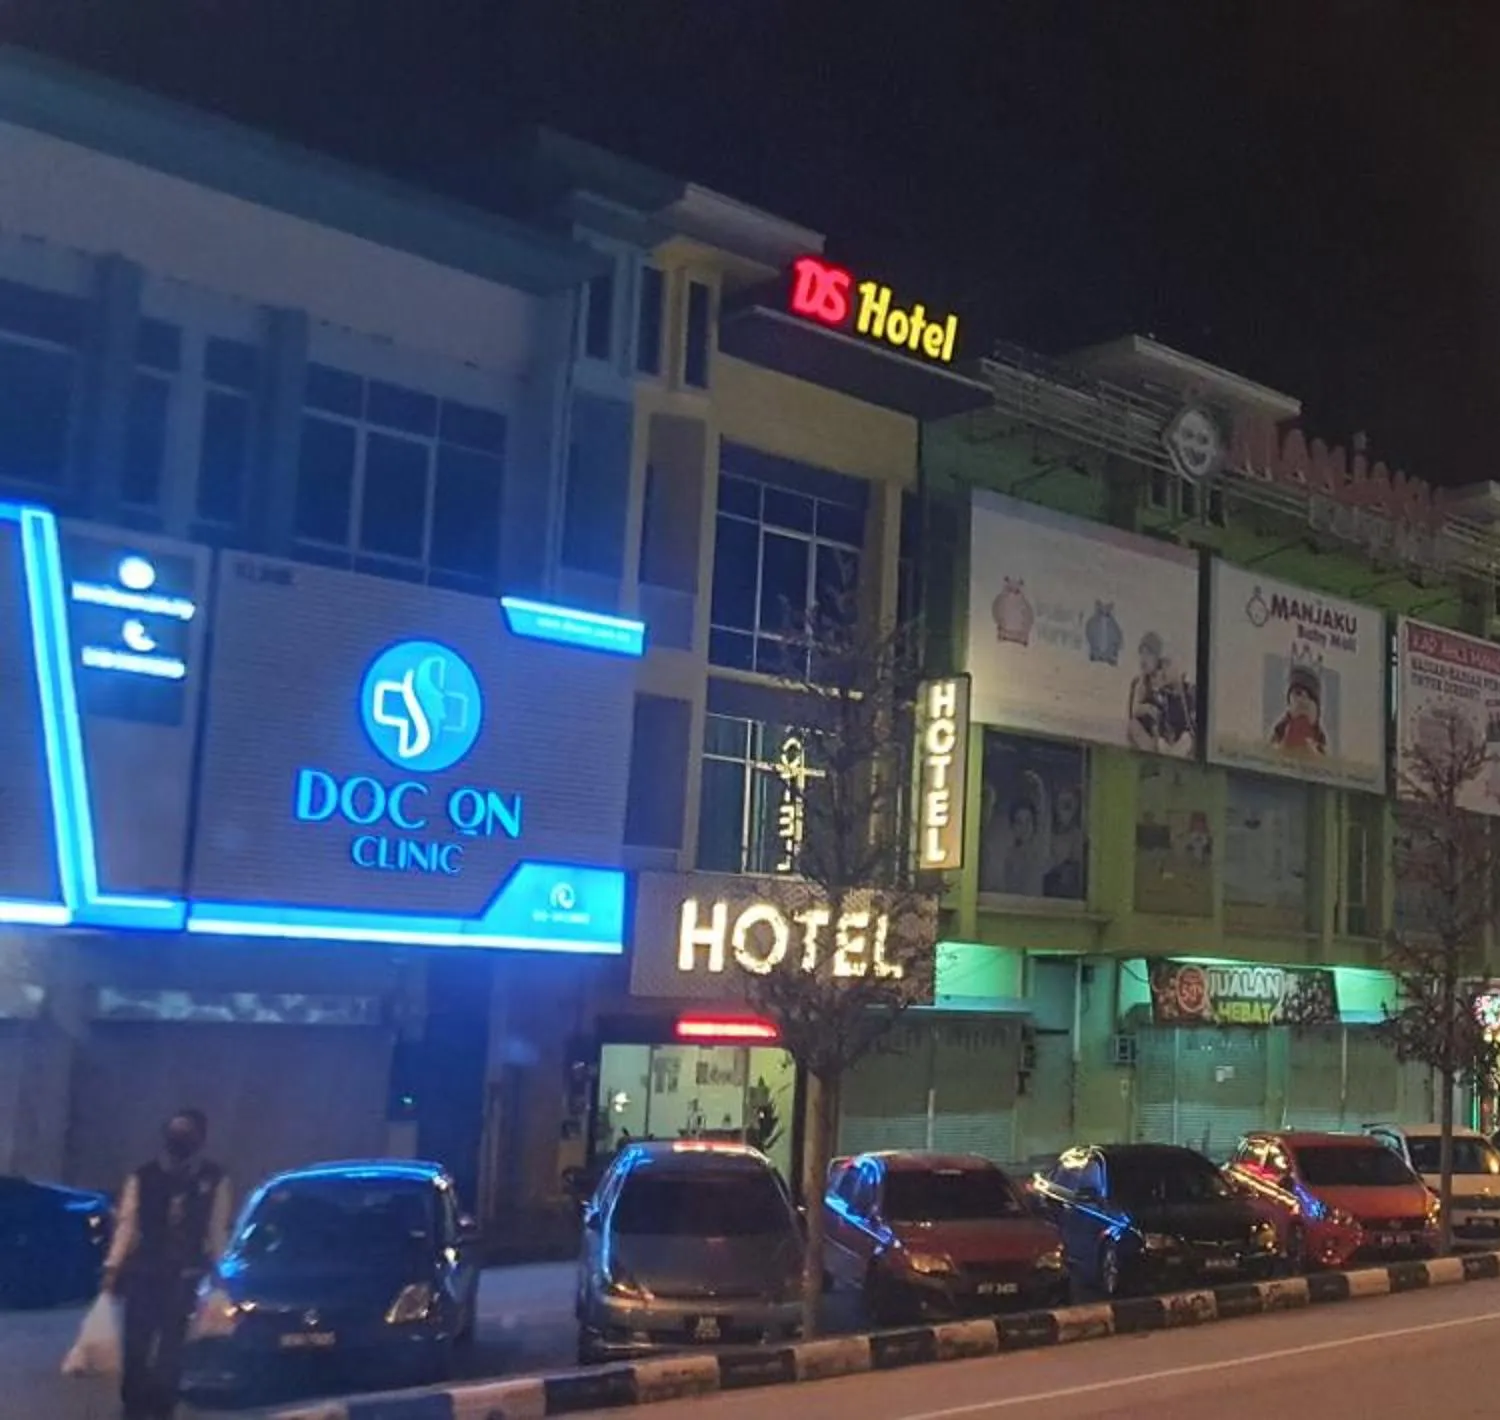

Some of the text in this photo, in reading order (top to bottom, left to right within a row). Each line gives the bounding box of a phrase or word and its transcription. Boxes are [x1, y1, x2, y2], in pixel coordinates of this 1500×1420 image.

[791, 258, 958, 362] DS Hotel
[1271, 592, 1357, 635] MANJAKU
[926, 682, 956, 863] HOTEL
[297, 768, 522, 839] DOC ON
[352, 834, 464, 874] CLINIC
[677, 899, 904, 978] HOTEL
[1209, 971, 1281, 999] JUALAN
[1218, 1001, 1272, 1024] HEBAT
